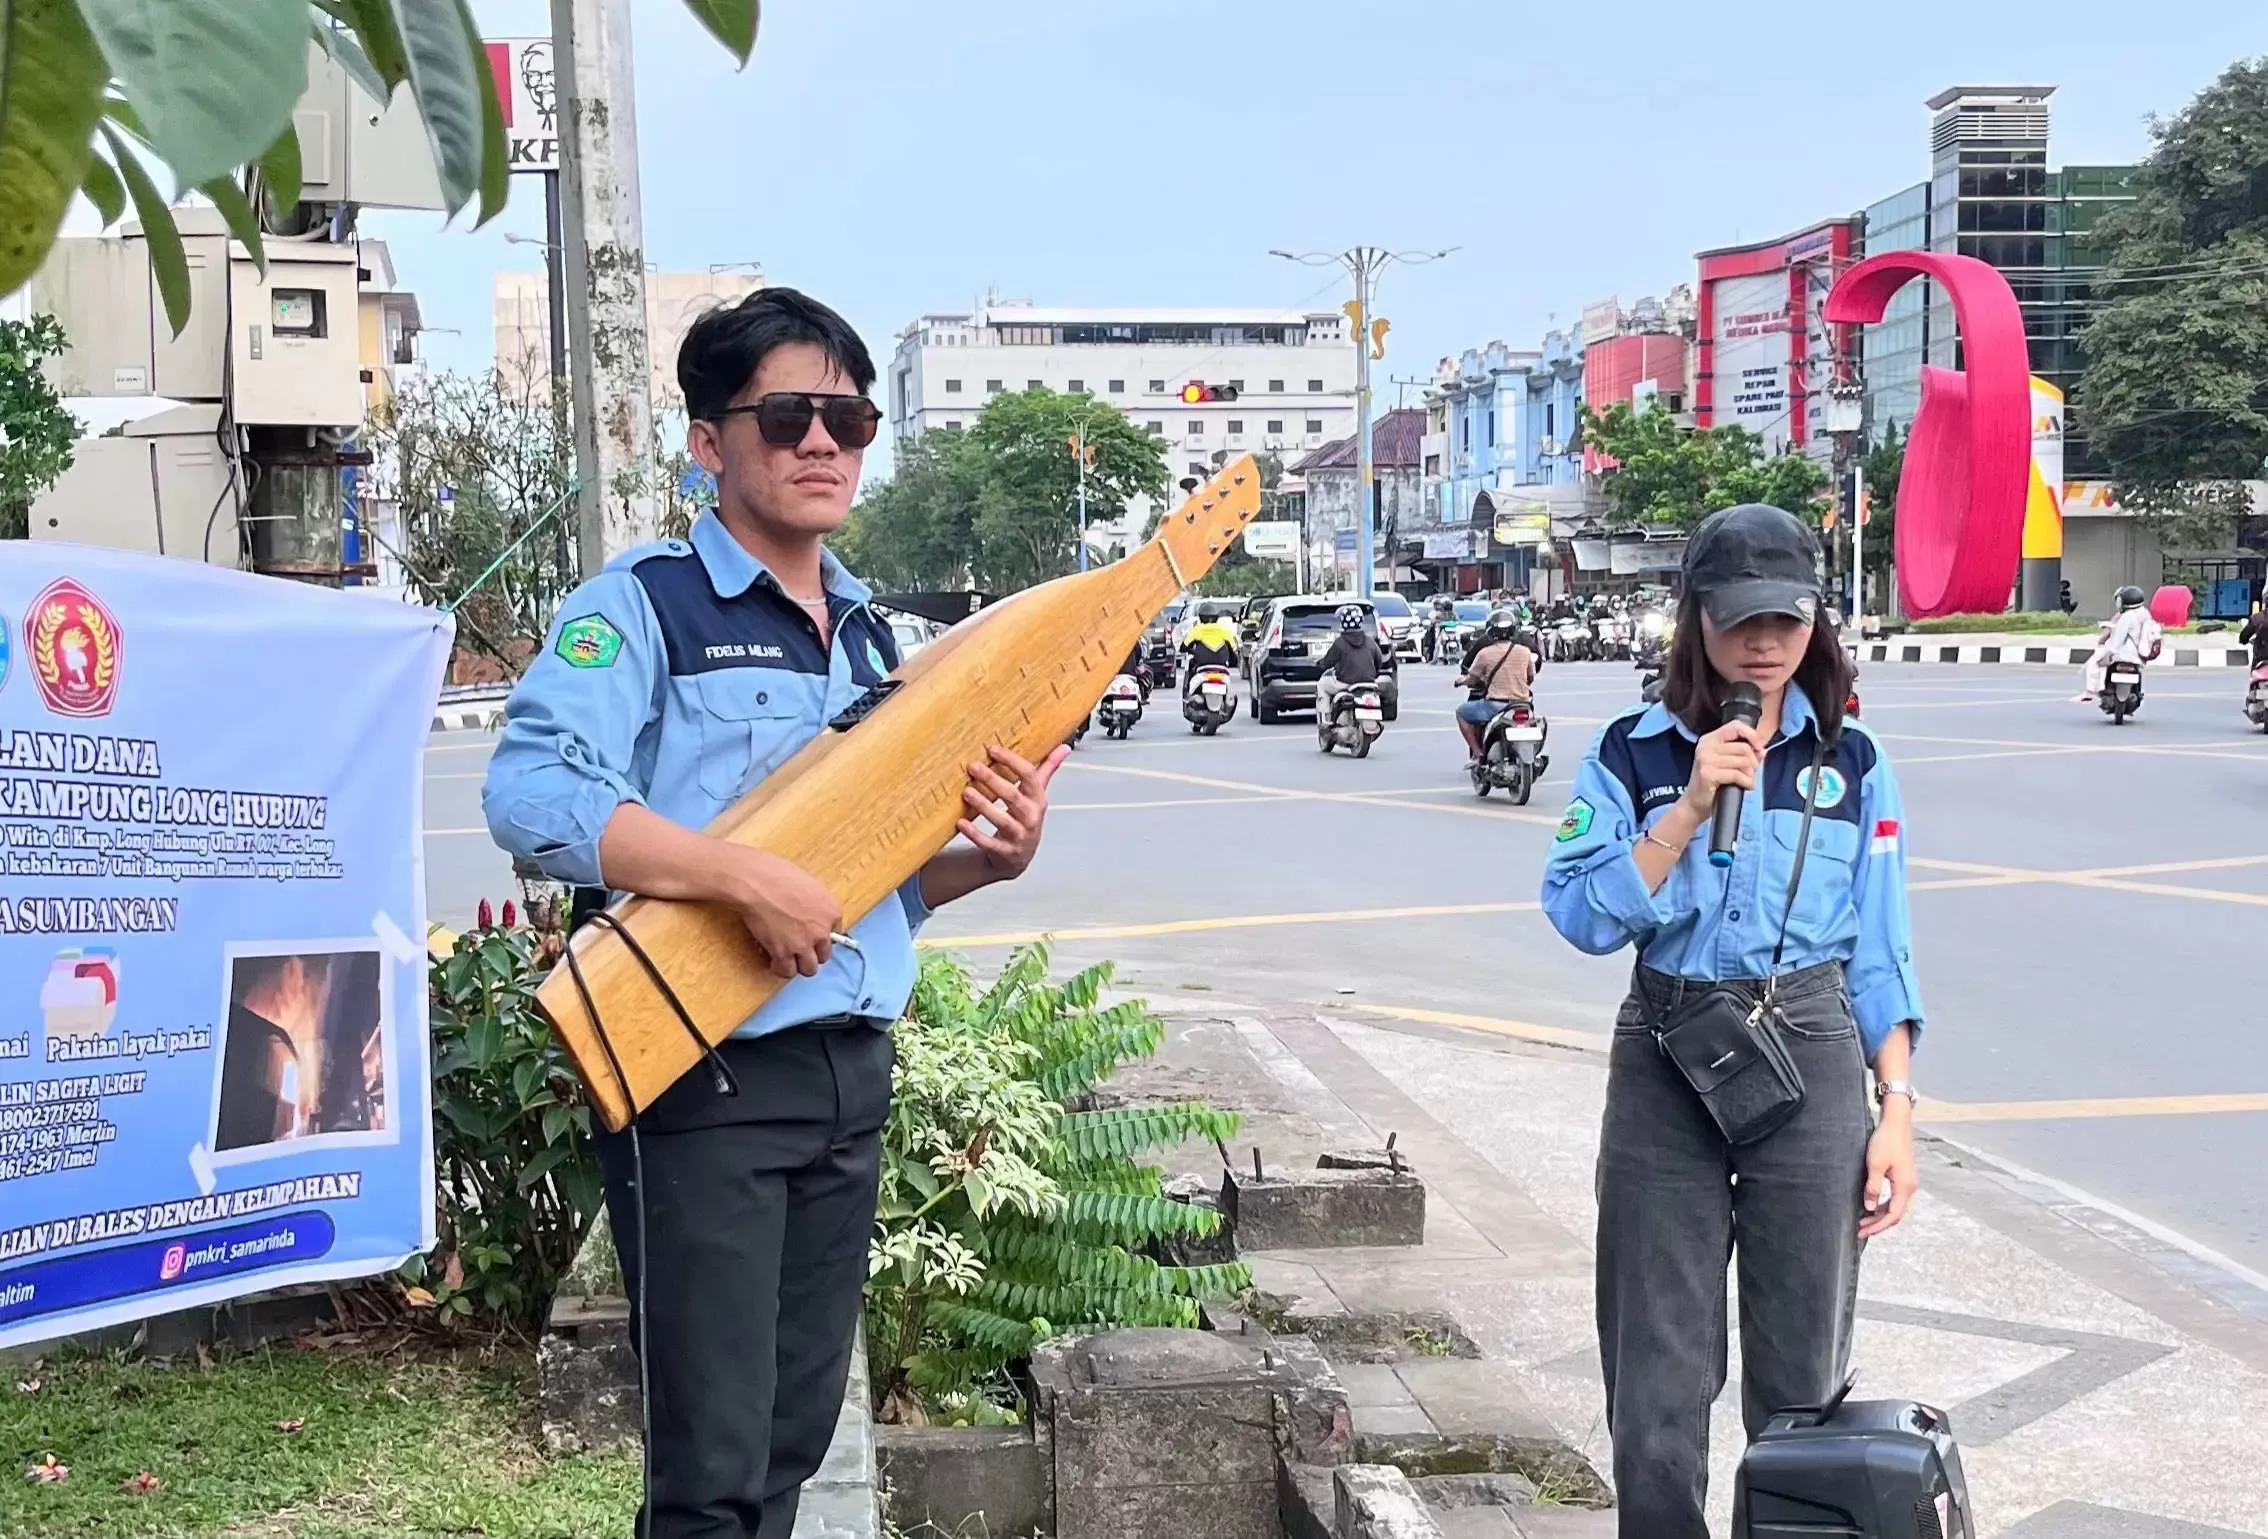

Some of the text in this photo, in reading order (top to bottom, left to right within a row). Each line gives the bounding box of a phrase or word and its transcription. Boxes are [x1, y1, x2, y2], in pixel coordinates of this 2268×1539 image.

[509, 139, 558, 163] KF
[705, 645, 746, 659] FIDELIS
[71, 733, 161, 778] DANA
[156, 786, 228, 826] LONG
[232, 792, 328, 830] HUBUNG
[5, 824, 51, 847] Wita
[52, 825, 70, 849] di
[72, 827, 114, 855] Kmp.
[115, 828, 151, 855] Long
[152, 829, 209, 857] Hubung
[209, 831, 235, 853] Ulu
[304, 834, 335, 860] Long
[8, 851, 98, 876] kebakaran
[98, 852, 111, 877] 7
[111, 854, 143, 877] Unit
[143, 855, 215, 882] Bangunan
[258, 862, 294, 883] warga
[47, 1024, 211, 1062] Pakaian layak pakai
[35, 1076, 100, 1104] SAGITA
[64, 1120, 117, 1147] Merlin
[50, 1217, 77, 1250] DI
[76, 1205, 148, 1244] BALES
[146, 1192, 232, 1233] DENGAN
[230, 1171, 361, 1218] KELIMPAHAN
[184, 1228, 295, 1273] pmkri_samarinda
